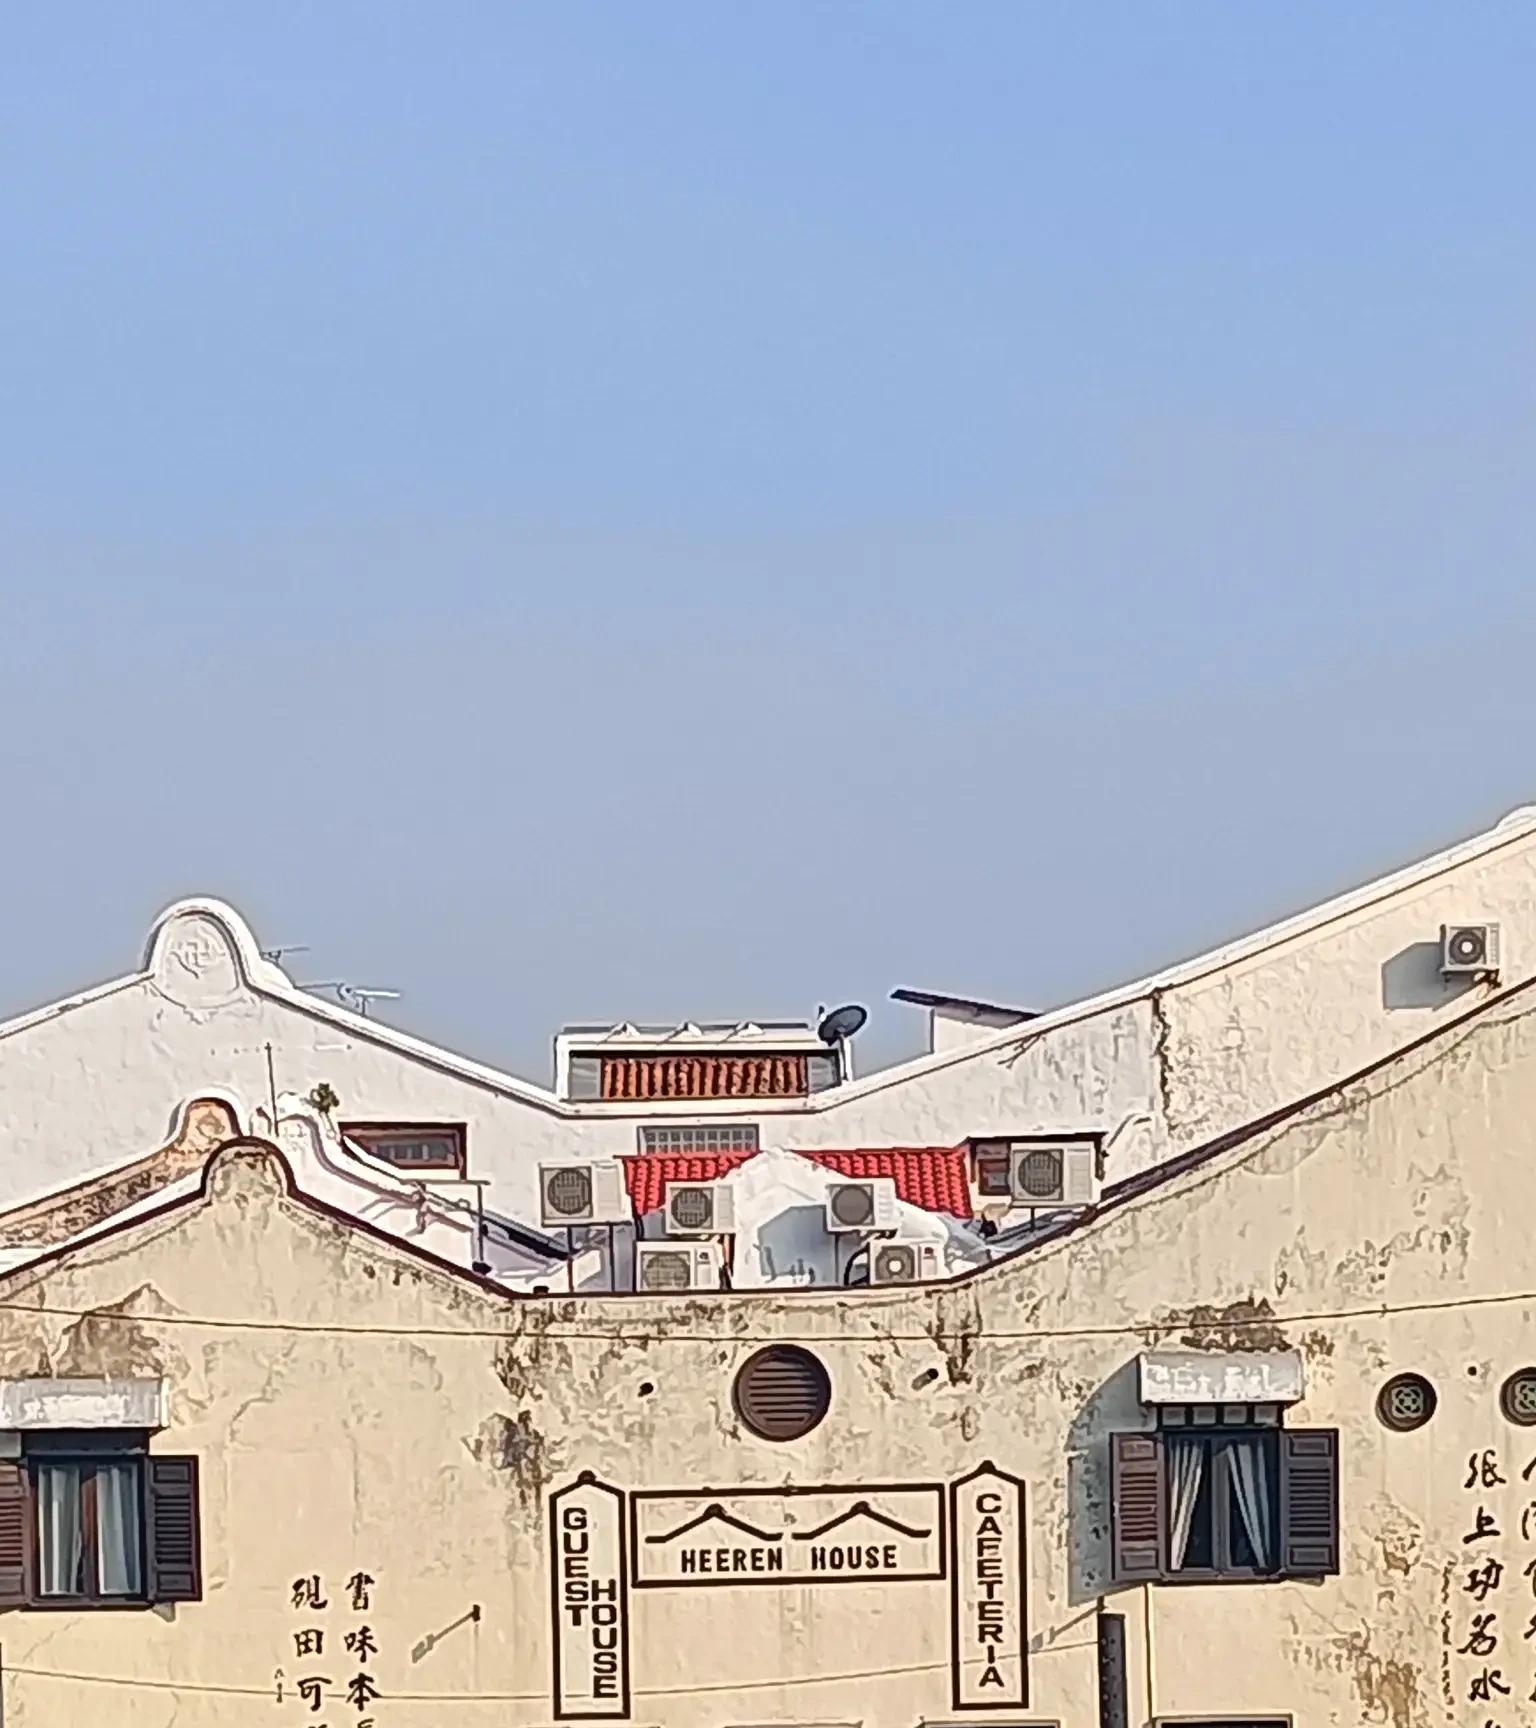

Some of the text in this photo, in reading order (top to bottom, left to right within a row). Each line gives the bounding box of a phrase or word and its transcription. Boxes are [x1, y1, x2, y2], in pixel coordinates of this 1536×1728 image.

[563, 1507, 619, 1699] GUEST HOUSE
[681, 1544, 897, 1574] HEEREN HOUSE
[976, 1493, 1005, 1687] CAFETERIA
